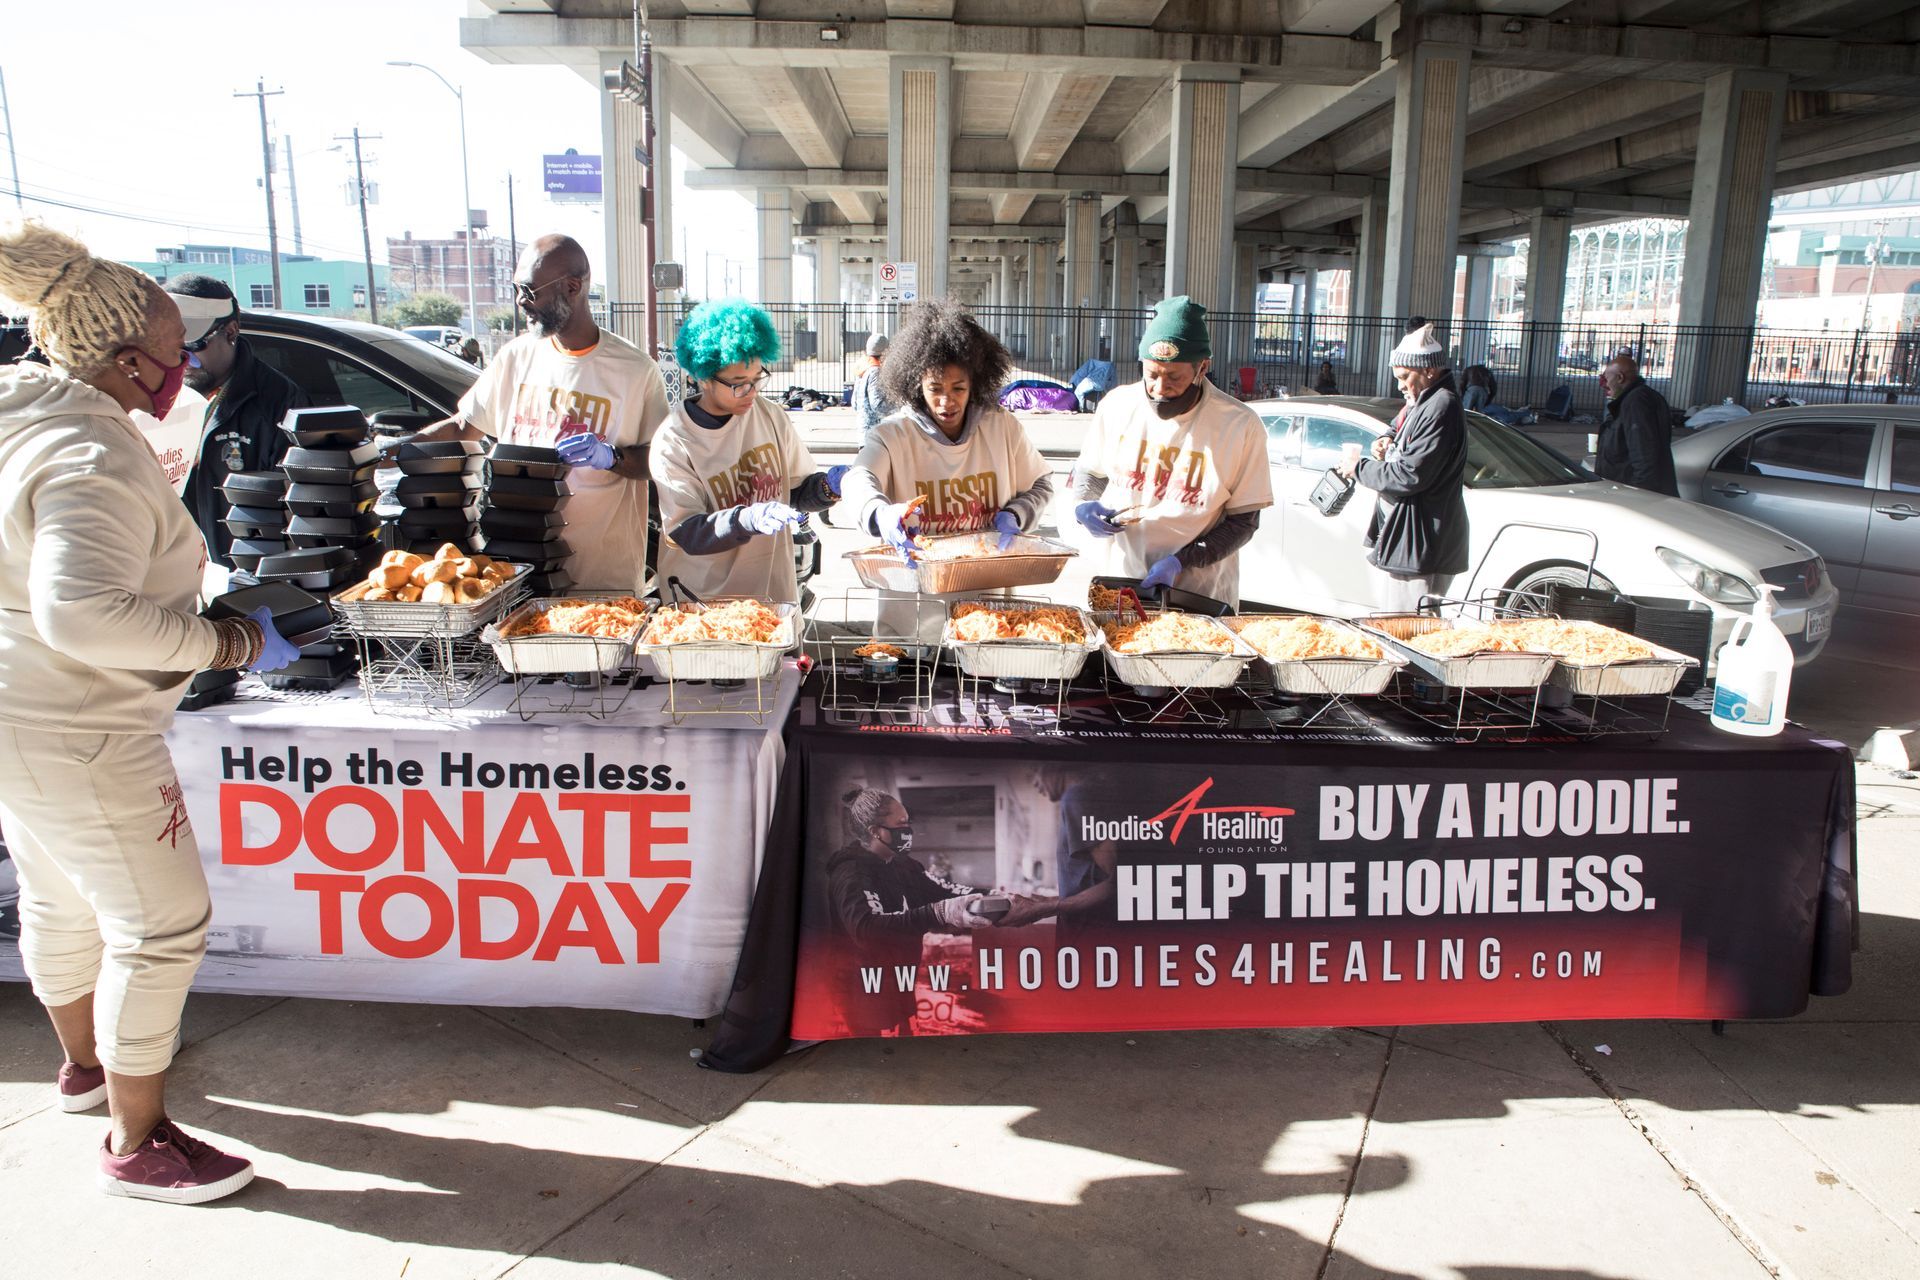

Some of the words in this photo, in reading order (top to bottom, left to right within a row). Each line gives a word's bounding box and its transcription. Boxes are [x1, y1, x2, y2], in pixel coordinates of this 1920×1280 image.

[1078, 730, 1139, 739] ONLINE.
[1140, 731, 1190, 739] ORDER
[1192, 732, 1251, 740] ONLINE.
[221, 746, 332, 793] Help
[346, 747, 424, 785] the
[440, 752, 686, 791] Homeless.
[219, 783, 692, 879] DONATE
[1082, 815, 1164, 841] Hoodies
[1202, 812, 1284, 845] Healing
[1318, 784, 1430, 841] BUY
[1436, 783, 1474, 839] A
[1483, 777, 1691, 837] HOODIE.
[1198, 845, 1289, 855] FOUNDATION
[1116, 862, 1246, 921] HELP
[1256, 861, 1356, 919] THE
[1368, 854, 1656, 916] HOMELESS.
[293, 871, 691, 964] TODAY
